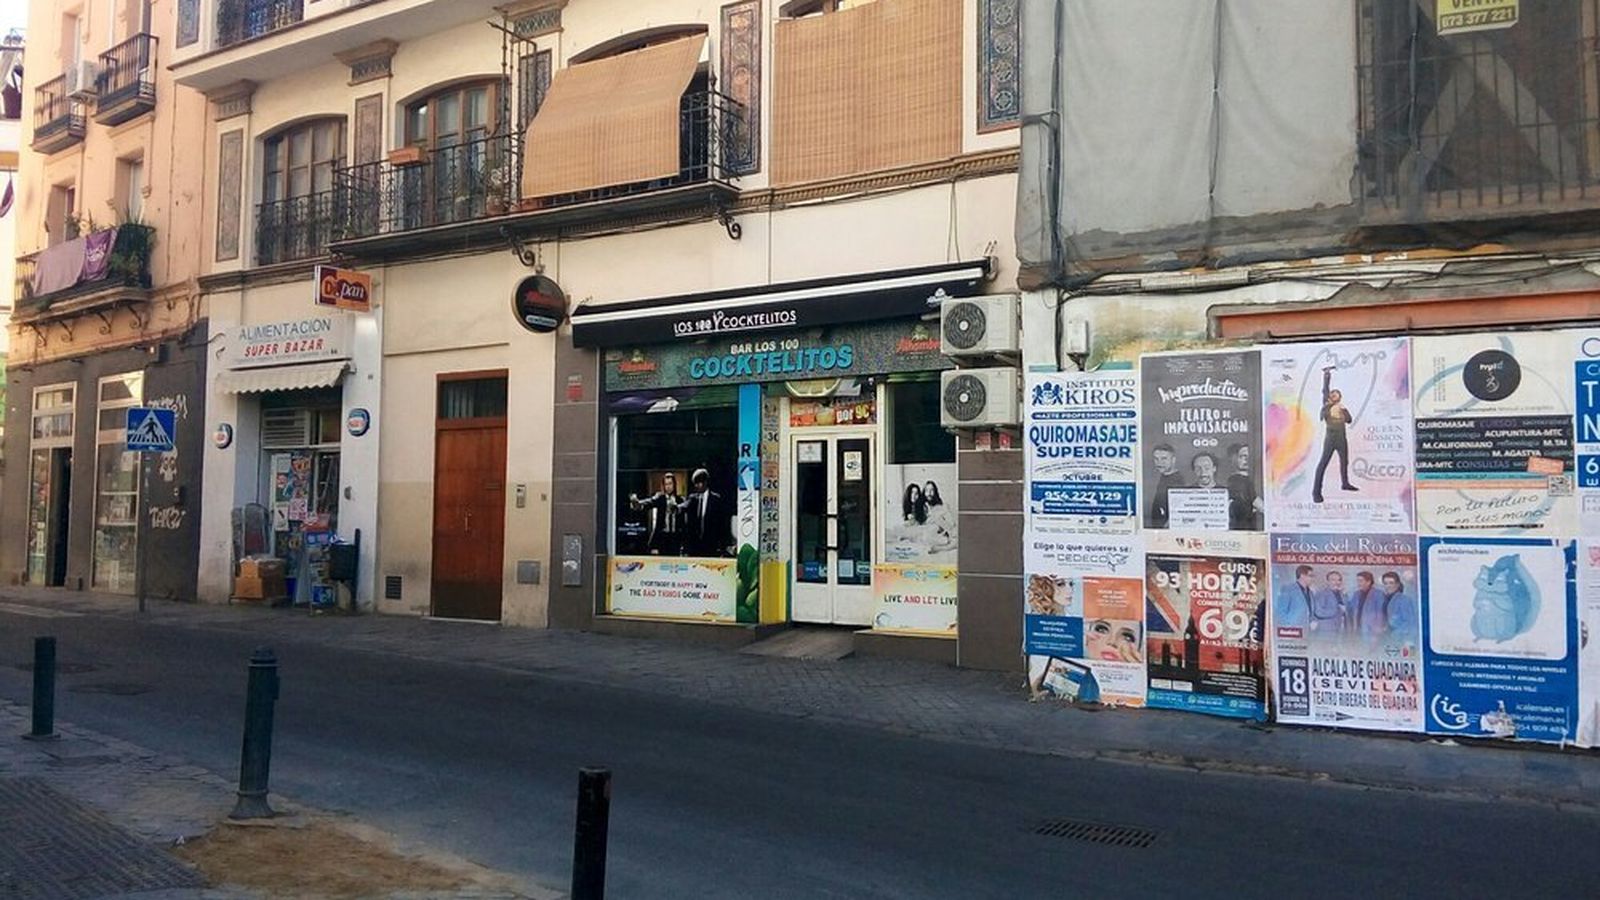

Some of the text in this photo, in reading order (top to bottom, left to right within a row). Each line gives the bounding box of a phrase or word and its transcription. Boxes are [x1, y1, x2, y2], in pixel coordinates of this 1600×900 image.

[1466, 12, 1489, 25] 377
[1491, 8, 1512, 21] 221
[674, 322, 694, 334] LOS
[723, 310, 797, 329] COCKTELITOS
[244, 342, 279, 358] SUPER
[284, 338, 325, 354] BAZAR
[731, 338, 799, 355] BAR LOS 100
[690, 345, 853, 380] COCKTELITOS
[1066, 379, 1135, 389] INSTITUTO
[1065, 389, 1135, 406] KIROS
[1180, 408, 1221, 422] TEATRO
[1417, 420, 1475, 431] QUIROMASAJE
[1029, 425, 1137, 447] QUIROMASAJE
[1484, 428, 1563, 439] ACUPUNTURA-MTC
[1037, 446, 1131, 458] SUPERIOR
[1063, 473, 1103, 481] OCTUBRE
[1034, 542, 1055, 552] Elige
[1056, 543, 1064, 551] lo
[1066, 544, 1083, 553] que
[1085, 545, 1117, 553] quieres
[1277, 537, 1318, 553] Ecos
[1324, 538, 1348, 553] del
[1057, 553, 1108, 564] CEDECO
[1316, 555, 1345, 563] NOCHE
[1218, 561, 1257, 575] CURSO
[1155, 571, 1258, 594] 93 HORAS
[629, 588, 641, 597] THE
[884, 595, 902, 604] LIVE
[904, 596, 921, 604] AND
[923, 596, 937, 604] LET
[1352, 660, 1365, 679] DE
[1281, 668, 1306, 695] 18
[1313, 690, 1337, 706] TEATRO
